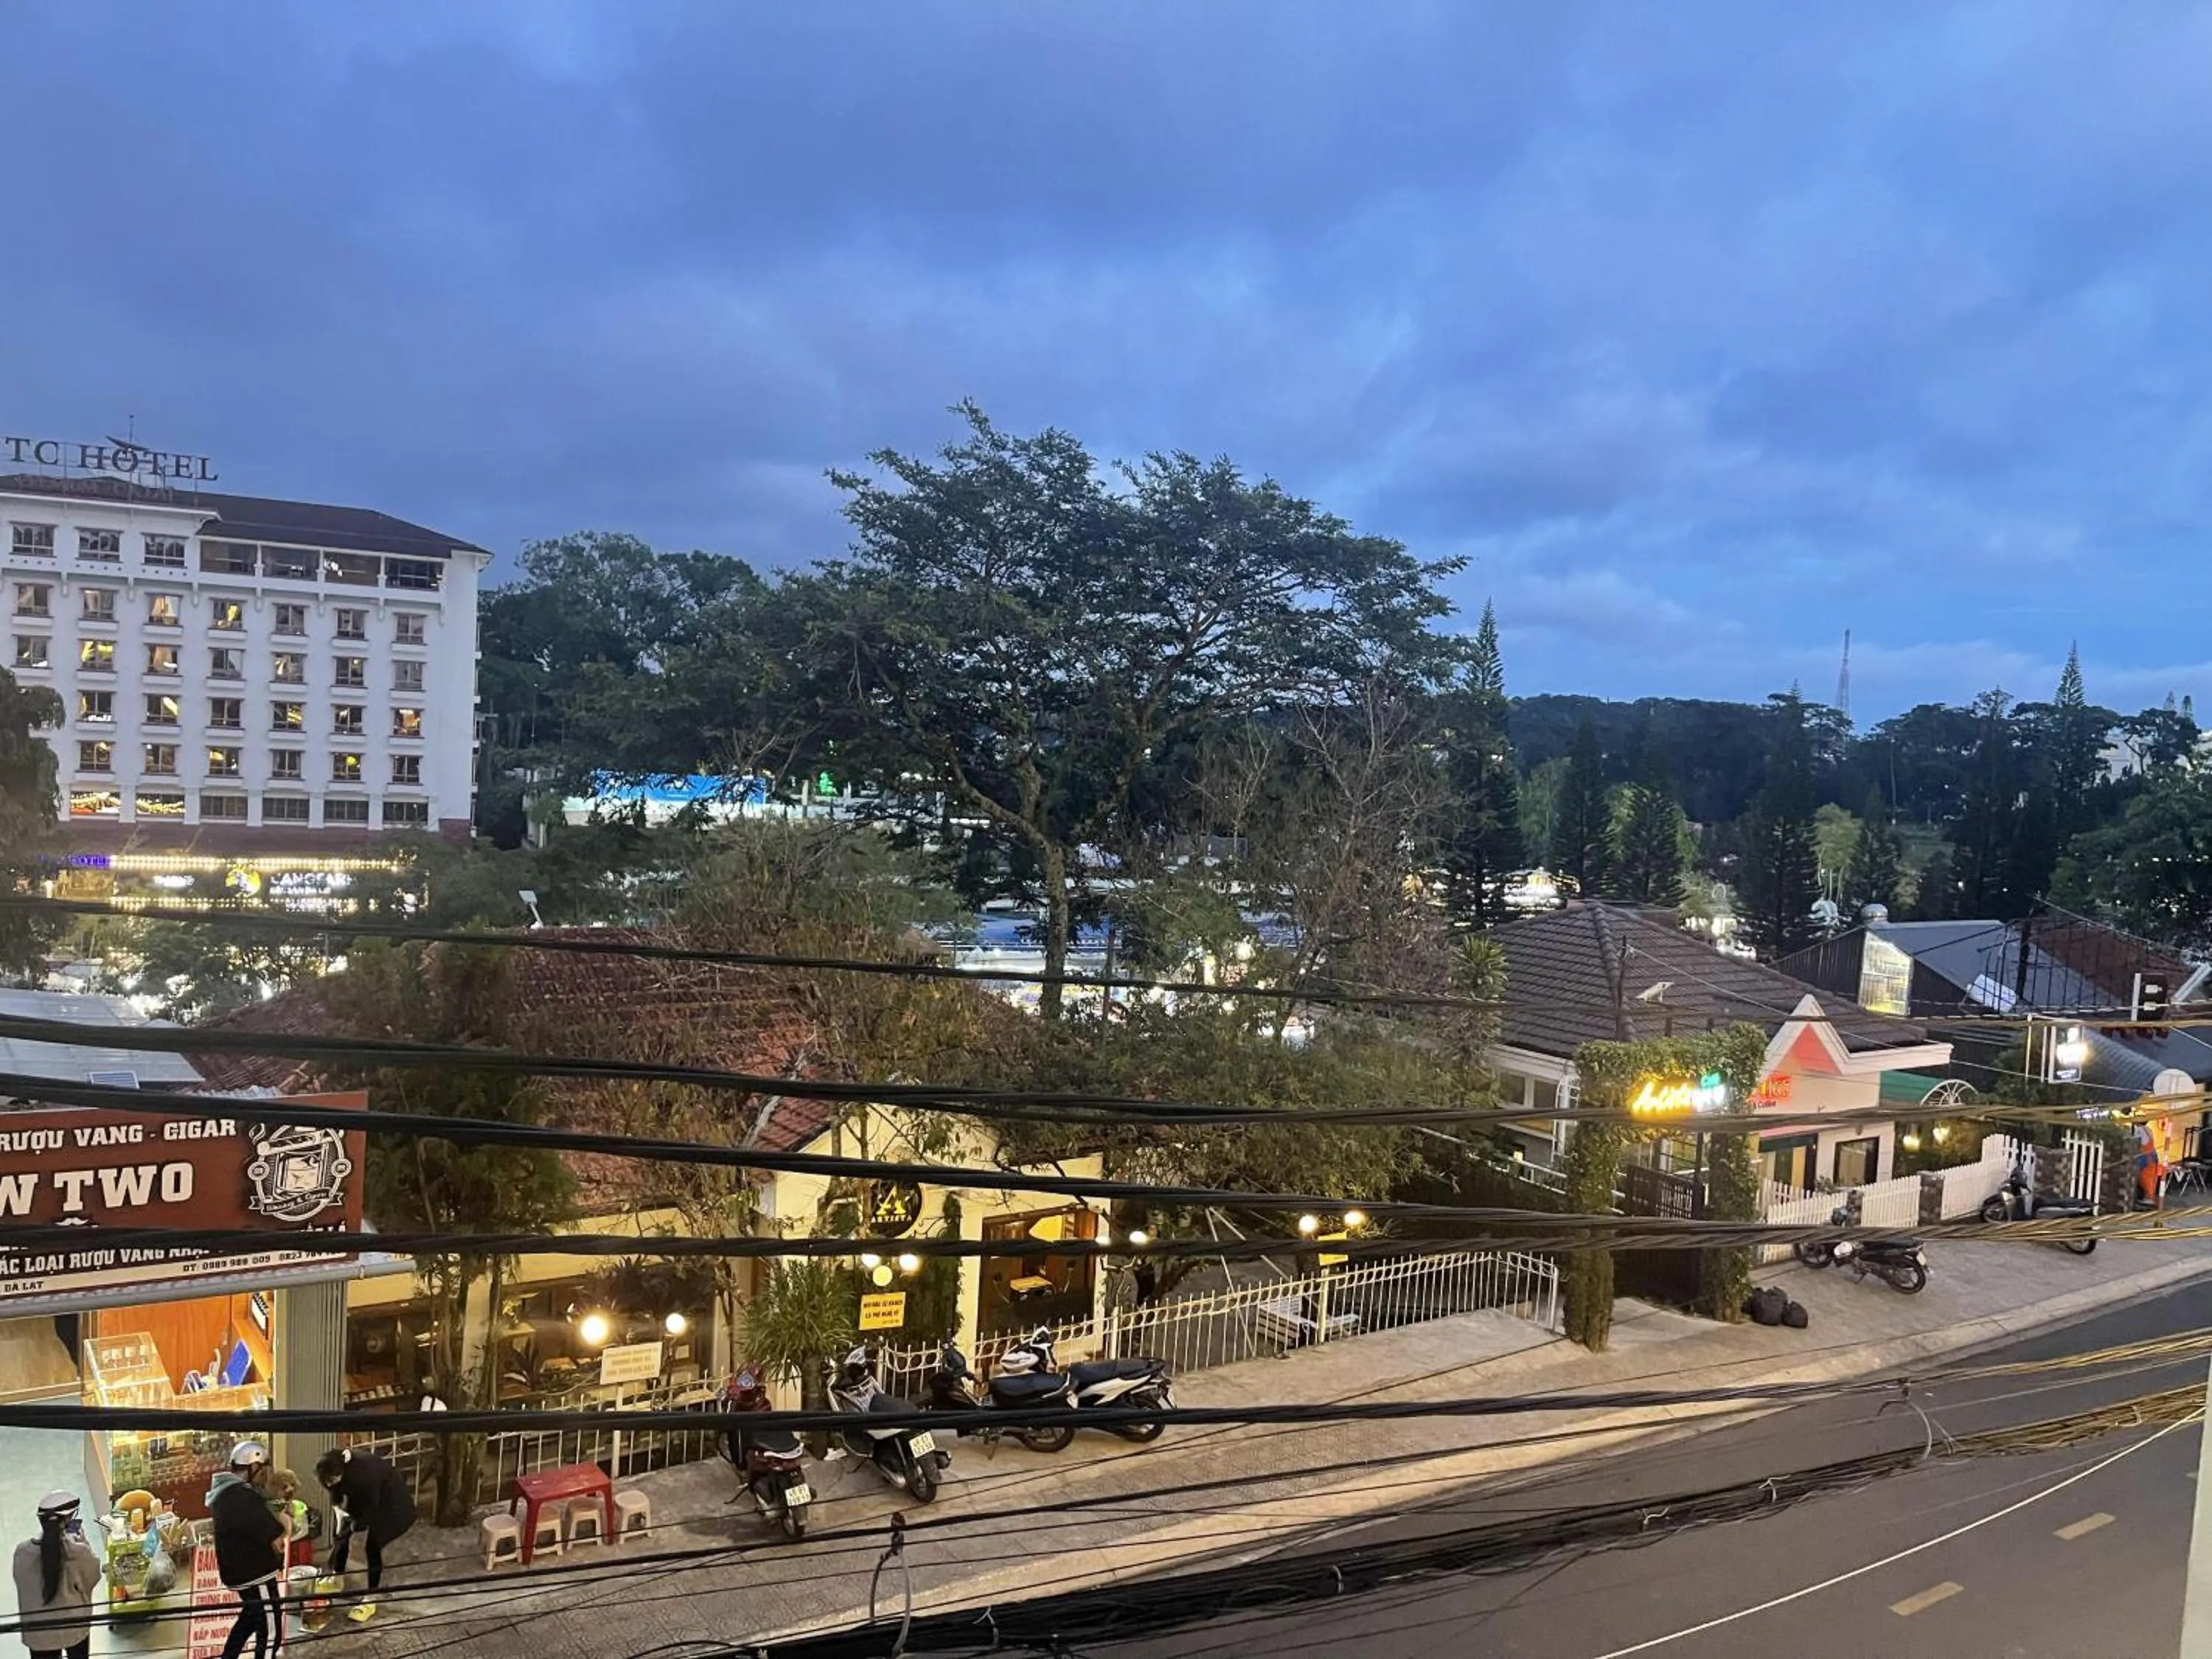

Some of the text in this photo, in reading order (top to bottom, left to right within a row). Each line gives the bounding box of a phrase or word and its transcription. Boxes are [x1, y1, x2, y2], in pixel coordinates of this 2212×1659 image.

[77, 442, 219, 481] HOTEL
[0, 1129, 64, 1155] RƯỢU
[74, 1124, 143, 1147] VANG
[54, 1162, 194, 1212] TWO
[24, 1254, 65, 1275] LOẠI
[69, 1249, 116, 1270] RƯỢU
